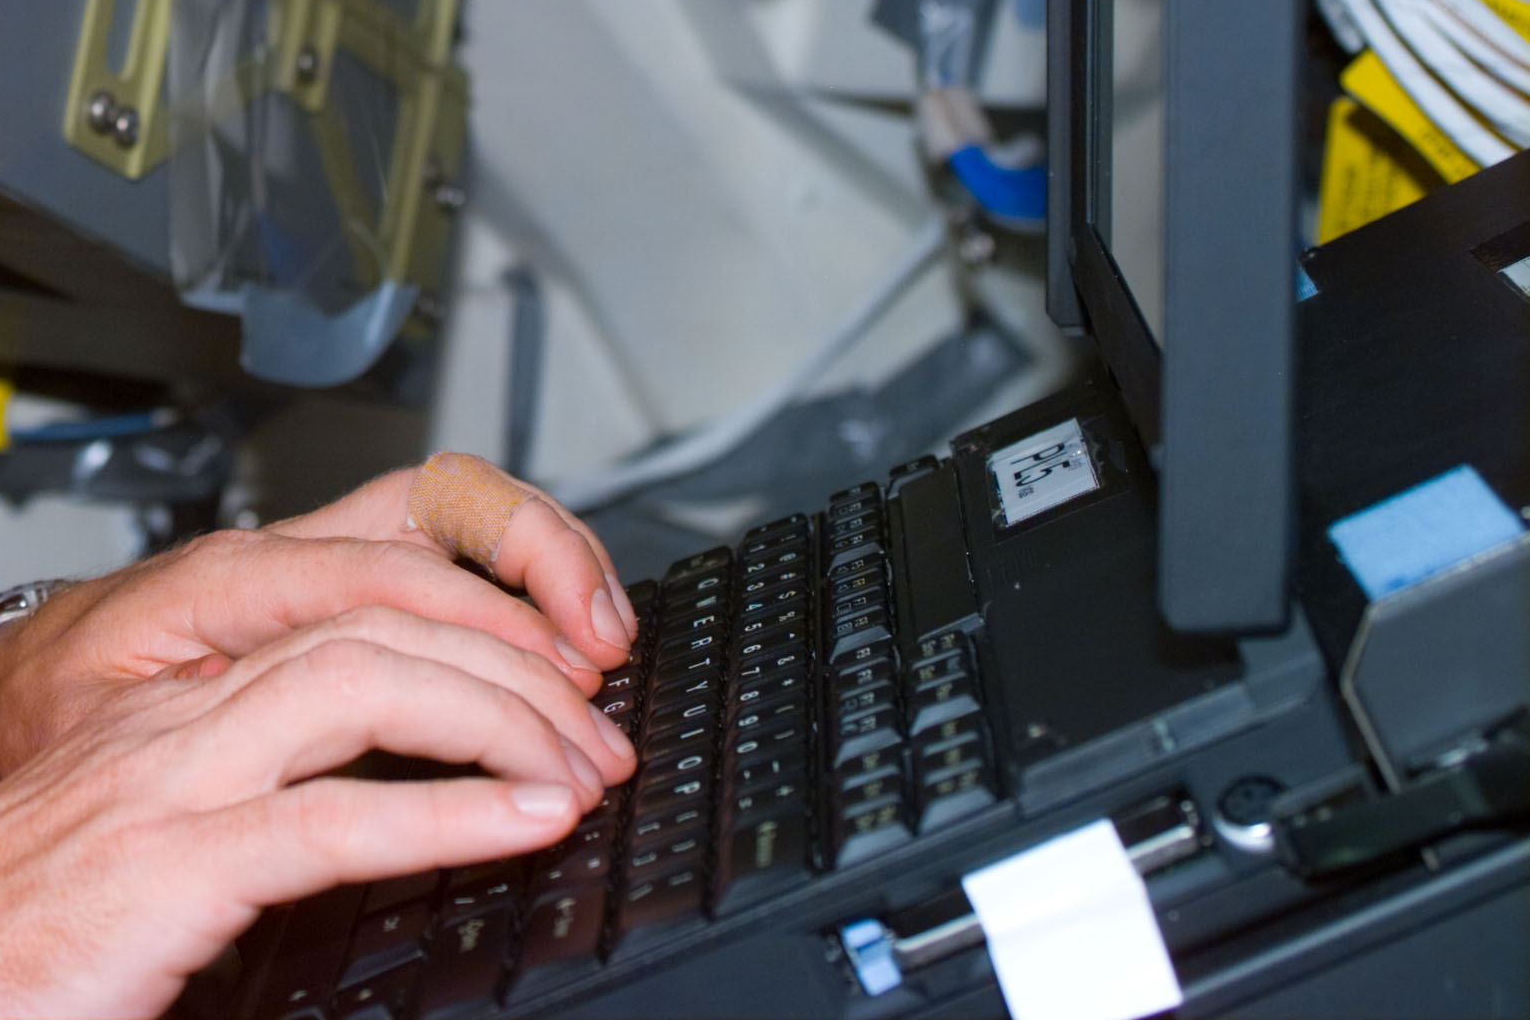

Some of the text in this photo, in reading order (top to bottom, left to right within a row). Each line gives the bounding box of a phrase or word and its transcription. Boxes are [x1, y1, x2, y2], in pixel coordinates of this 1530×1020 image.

[1010, 442, 1070, 487] PL5
[750, 544, 766, 553] 1
[747, 563, 765, 573] 2
[747, 582, 764, 591] 3
[746, 603, 763, 612] 4
[693, 615, 714, 628] E
[744, 622, 762, 631] 5
[691, 636, 712, 649] R
[743, 644, 761, 653] 6
[688, 657, 710, 669] T
[777, 655, 795, 666] &
[741, 666, 760, 675] 7
[608, 677, 630, 687] F
[685, 681, 708, 692] Y
[740, 691, 759, 701] 8
[604, 701, 625, 713] G
[683, 704, 706, 717] U
[738, 715, 759, 727] 9
[680, 728, 704, 739] I
[736, 741, 758, 754] 0
[677, 756, 702, 769] O
[674, 780, 701, 794] P
